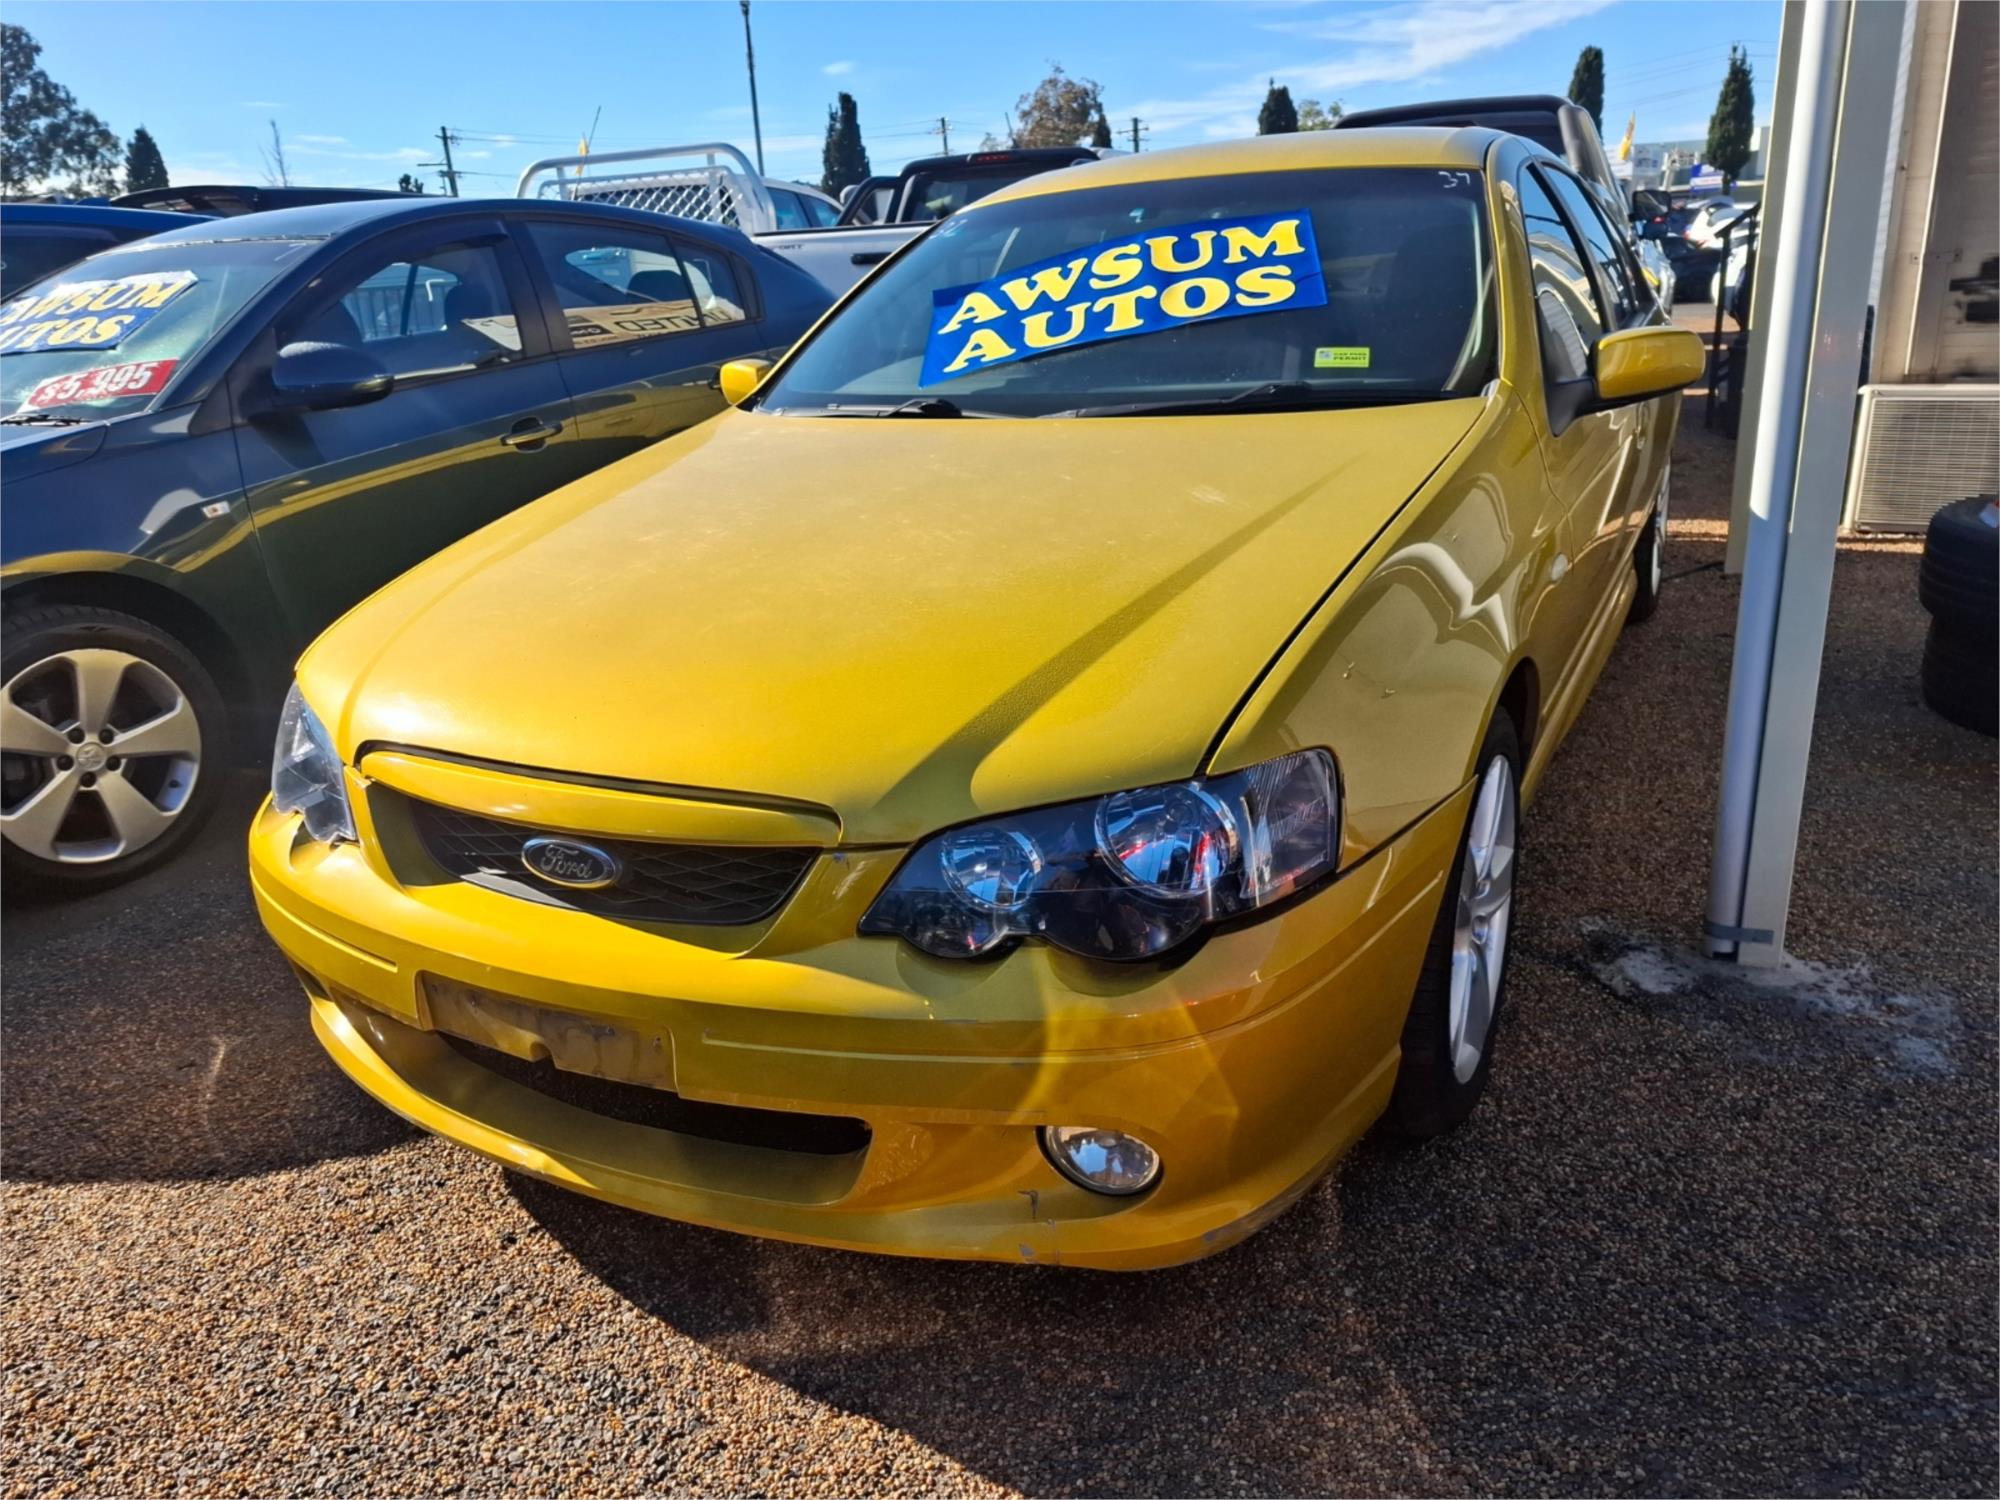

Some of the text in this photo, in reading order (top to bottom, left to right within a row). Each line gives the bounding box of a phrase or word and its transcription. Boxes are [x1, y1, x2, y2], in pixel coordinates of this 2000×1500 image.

[937, 219, 1305, 335] AWSUM
[943, 265, 1296, 373] AUTOS
[39, 362, 162, 401] $5,995
[540, 844, 593, 878] Ford
